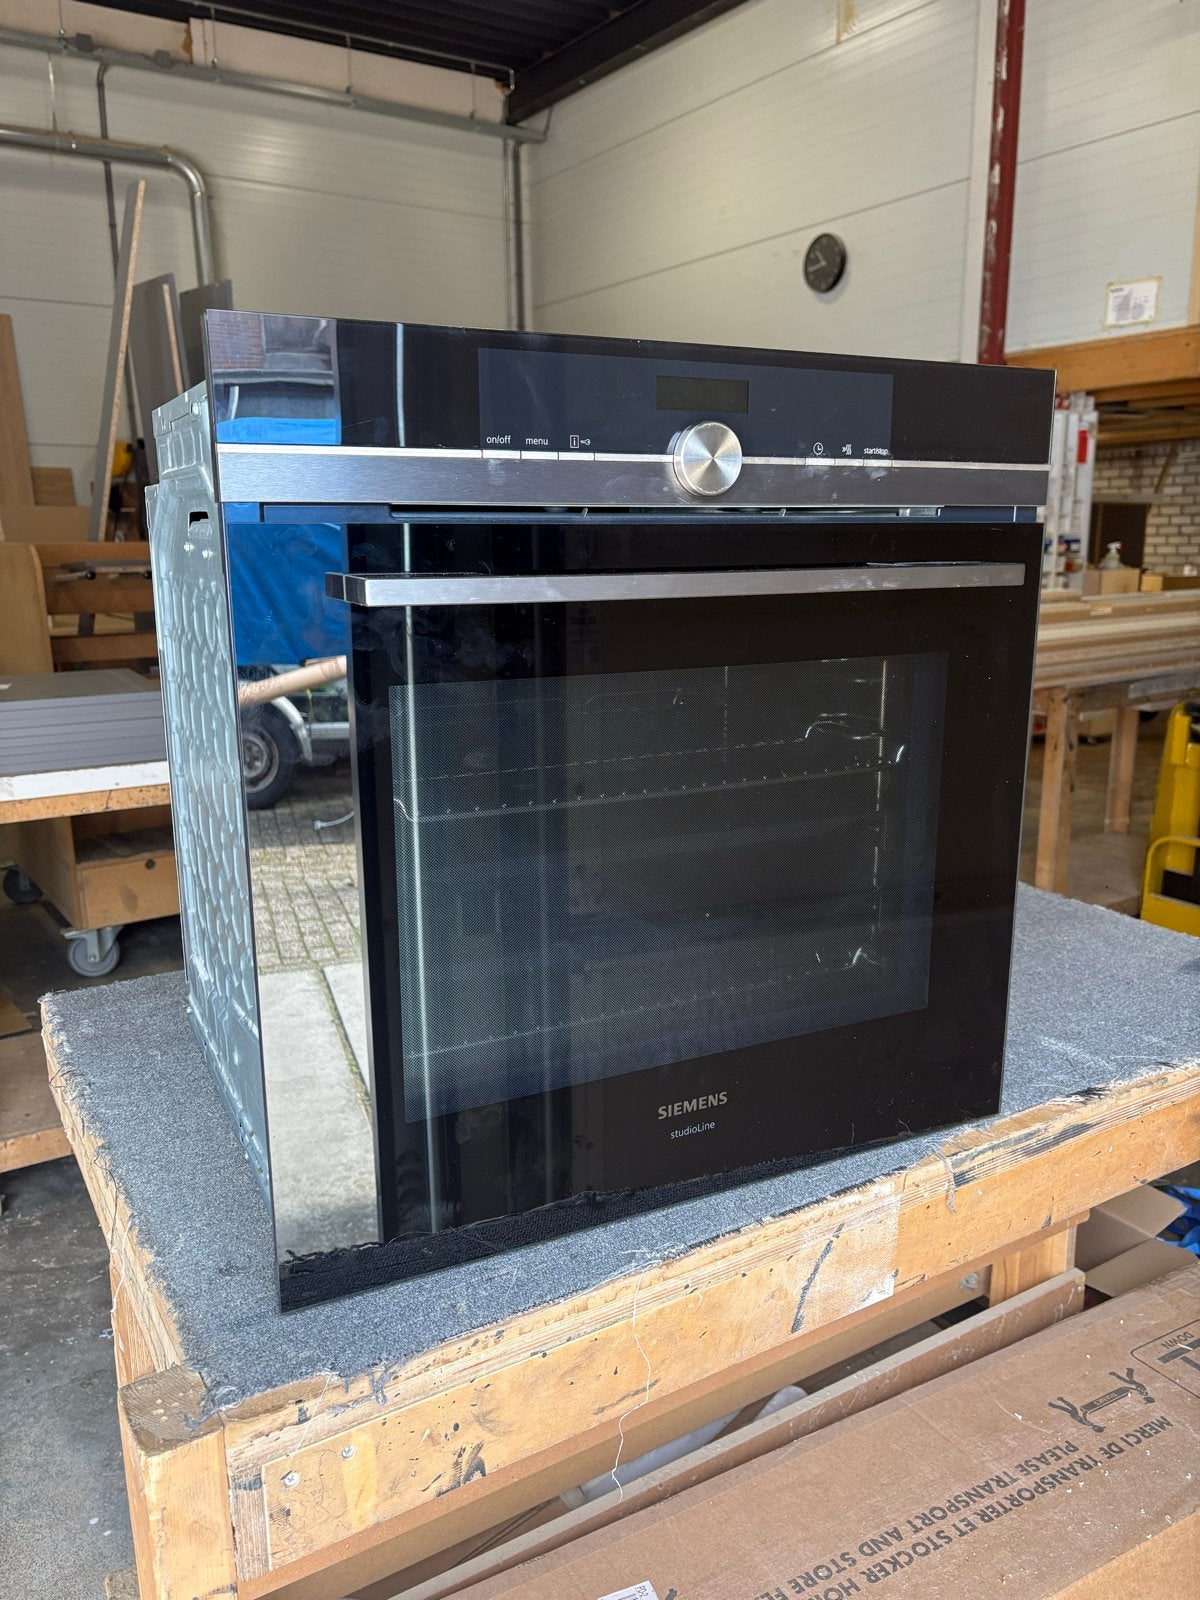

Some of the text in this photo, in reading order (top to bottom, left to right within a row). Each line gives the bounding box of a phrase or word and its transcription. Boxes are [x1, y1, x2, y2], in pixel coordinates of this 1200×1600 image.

[486, 435, 511, 444] on/off
[525, 437, 549, 446] menu
[658, 1091, 728, 1120] SIEMENS
[670, 1121, 716, 1139] studioLine
[1161, 1331, 1194, 1349] DOWN
[1119, 1415, 1174, 1448] MERCI
[1014, 1439, 1080, 1476] PLEASE
[1098, 1441, 1126, 1460] DE
[906, 1471, 1019, 1534] TRANSPORT
[974, 1454, 1103, 1524] TRANSPORTER
[858, 1526, 904, 1557] AND
[952, 1517, 978, 1537] ET
[859, 1529, 953, 1584] STOCKER
[787, 1551, 858, 1595] STORE
